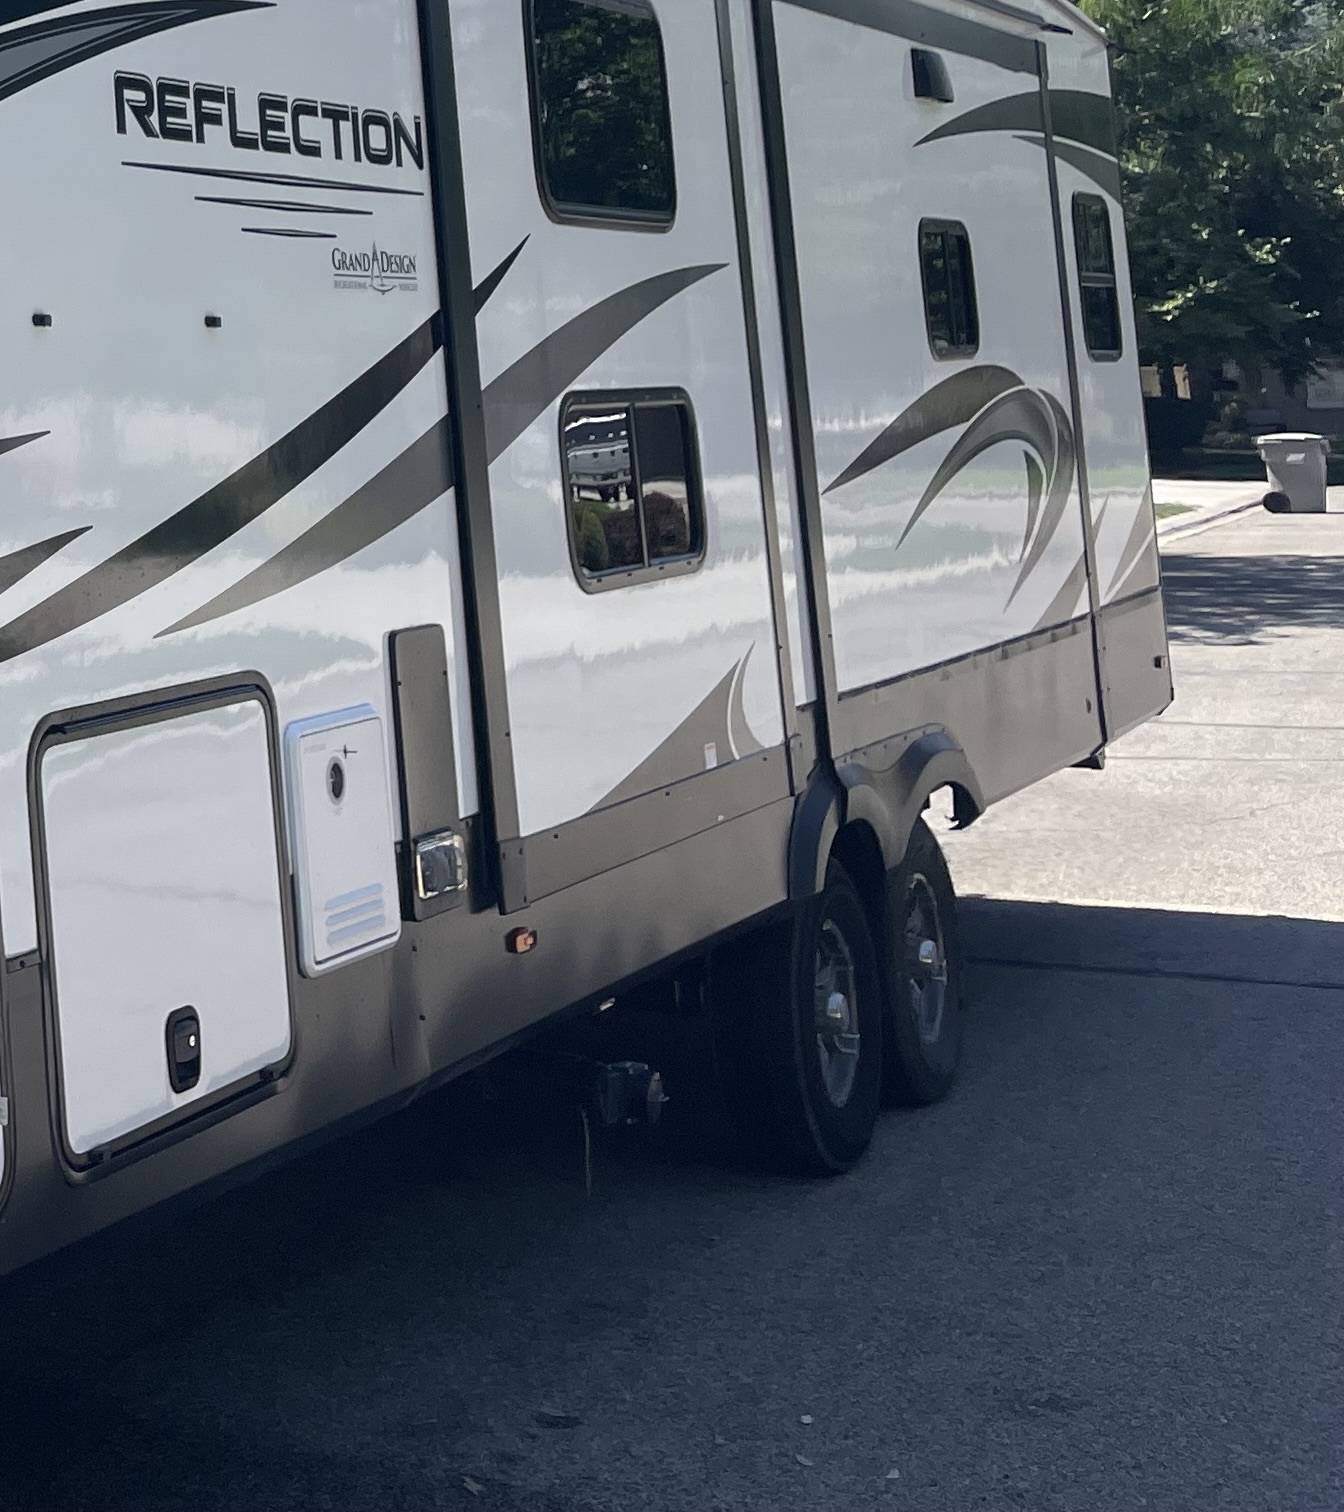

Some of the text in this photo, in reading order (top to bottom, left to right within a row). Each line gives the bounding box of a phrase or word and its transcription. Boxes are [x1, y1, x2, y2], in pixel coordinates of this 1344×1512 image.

[113, 69, 424, 171] REFLECTION
[331, 247, 417, 274] GRAND DESIGN
